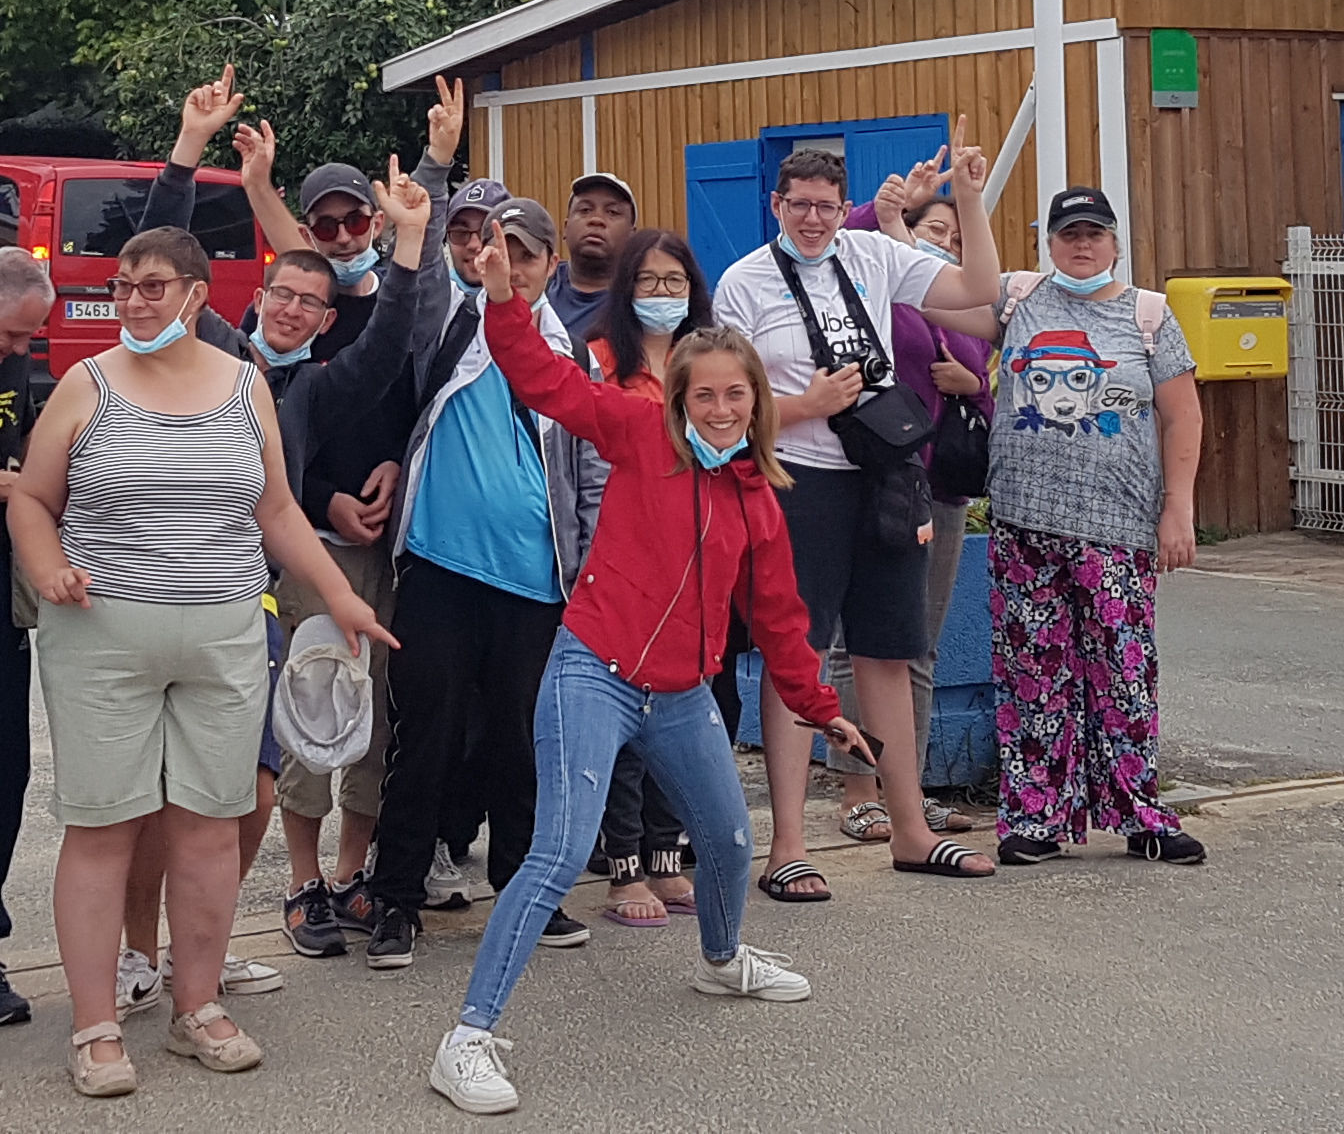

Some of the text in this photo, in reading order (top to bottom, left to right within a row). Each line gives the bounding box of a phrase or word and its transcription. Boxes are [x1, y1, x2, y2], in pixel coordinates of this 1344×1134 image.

[74, 303, 110, 317] 5463
[1101, 387, 1135, 407] For
[651, 850, 682, 873] UNS
